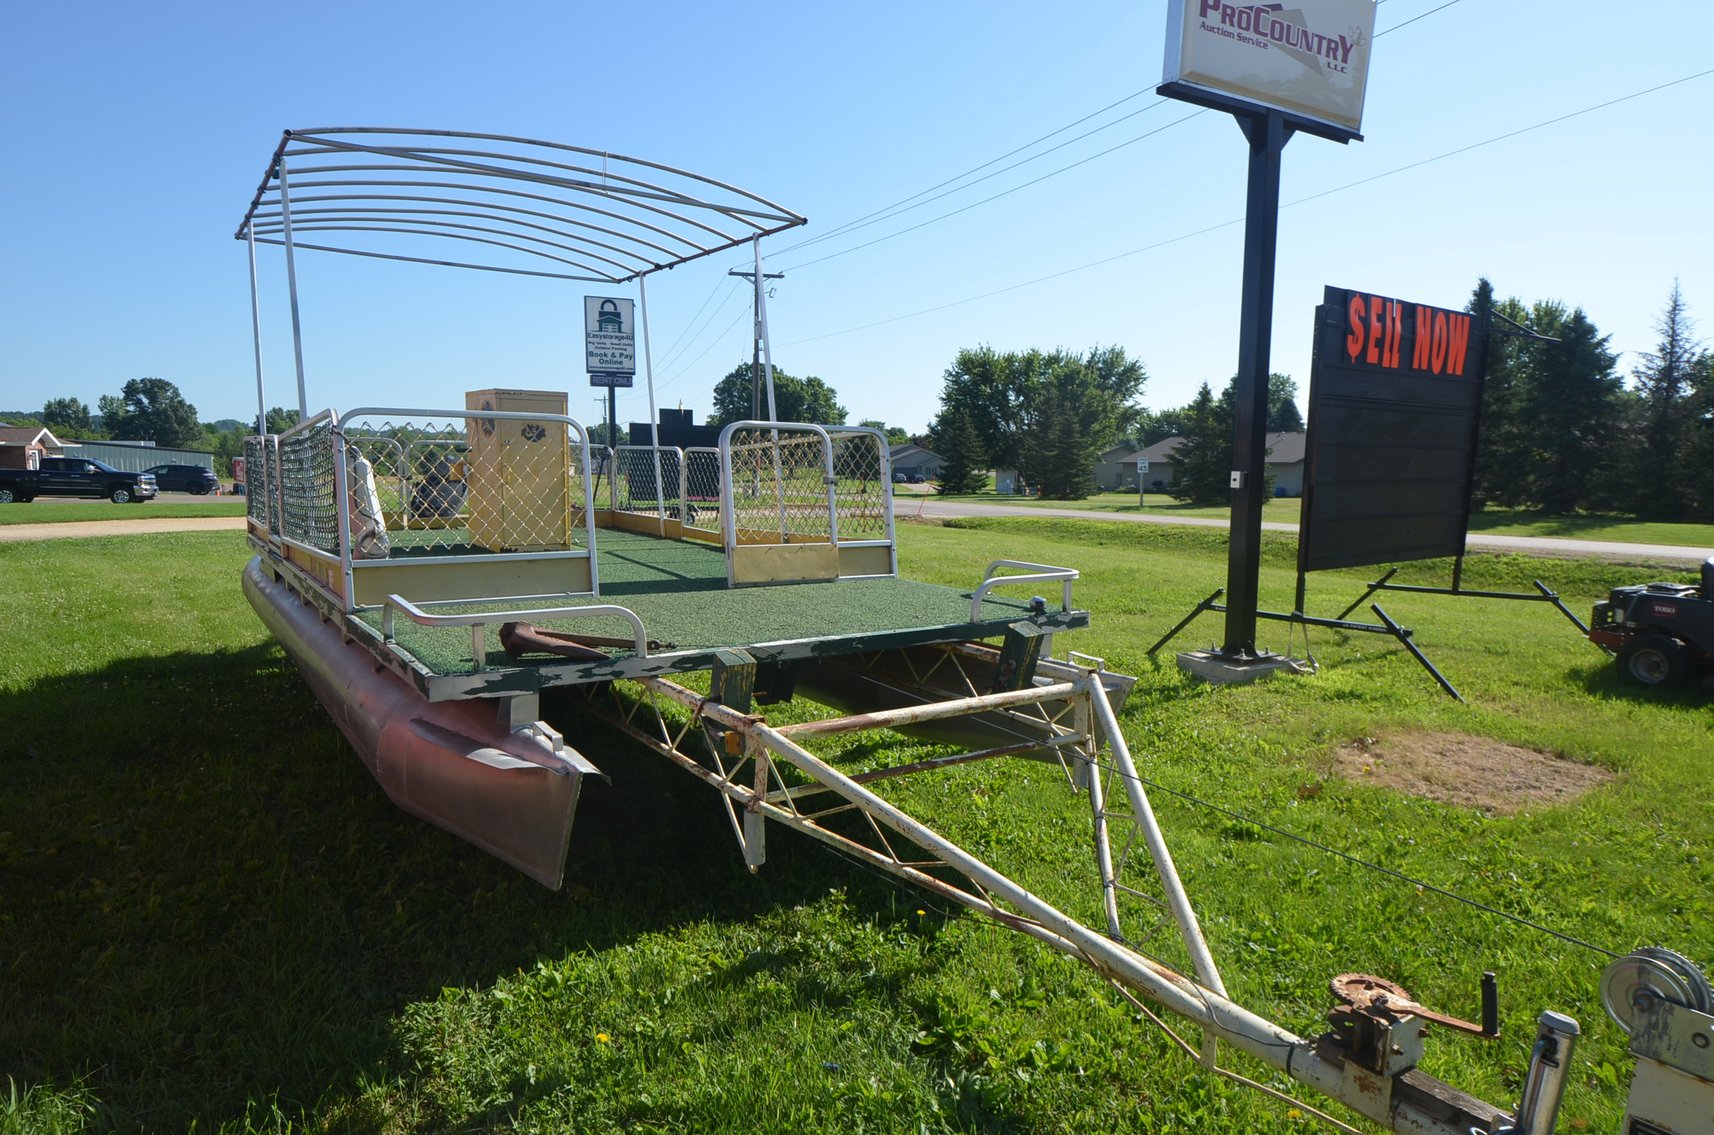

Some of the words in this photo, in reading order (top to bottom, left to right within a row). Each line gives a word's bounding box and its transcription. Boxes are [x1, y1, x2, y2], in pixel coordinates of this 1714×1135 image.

[1200, 20, 1235, 39] Auction
[1236, 32, 1269, 50] Service
[1327, 62, 1347, 74] LLC
[1413, 305, 1471, 376] NOW
[619, 353, 633, 361] Pay
[592, 376, 613, 385] RENT
[1653, 605, 1675, 613] TORO
